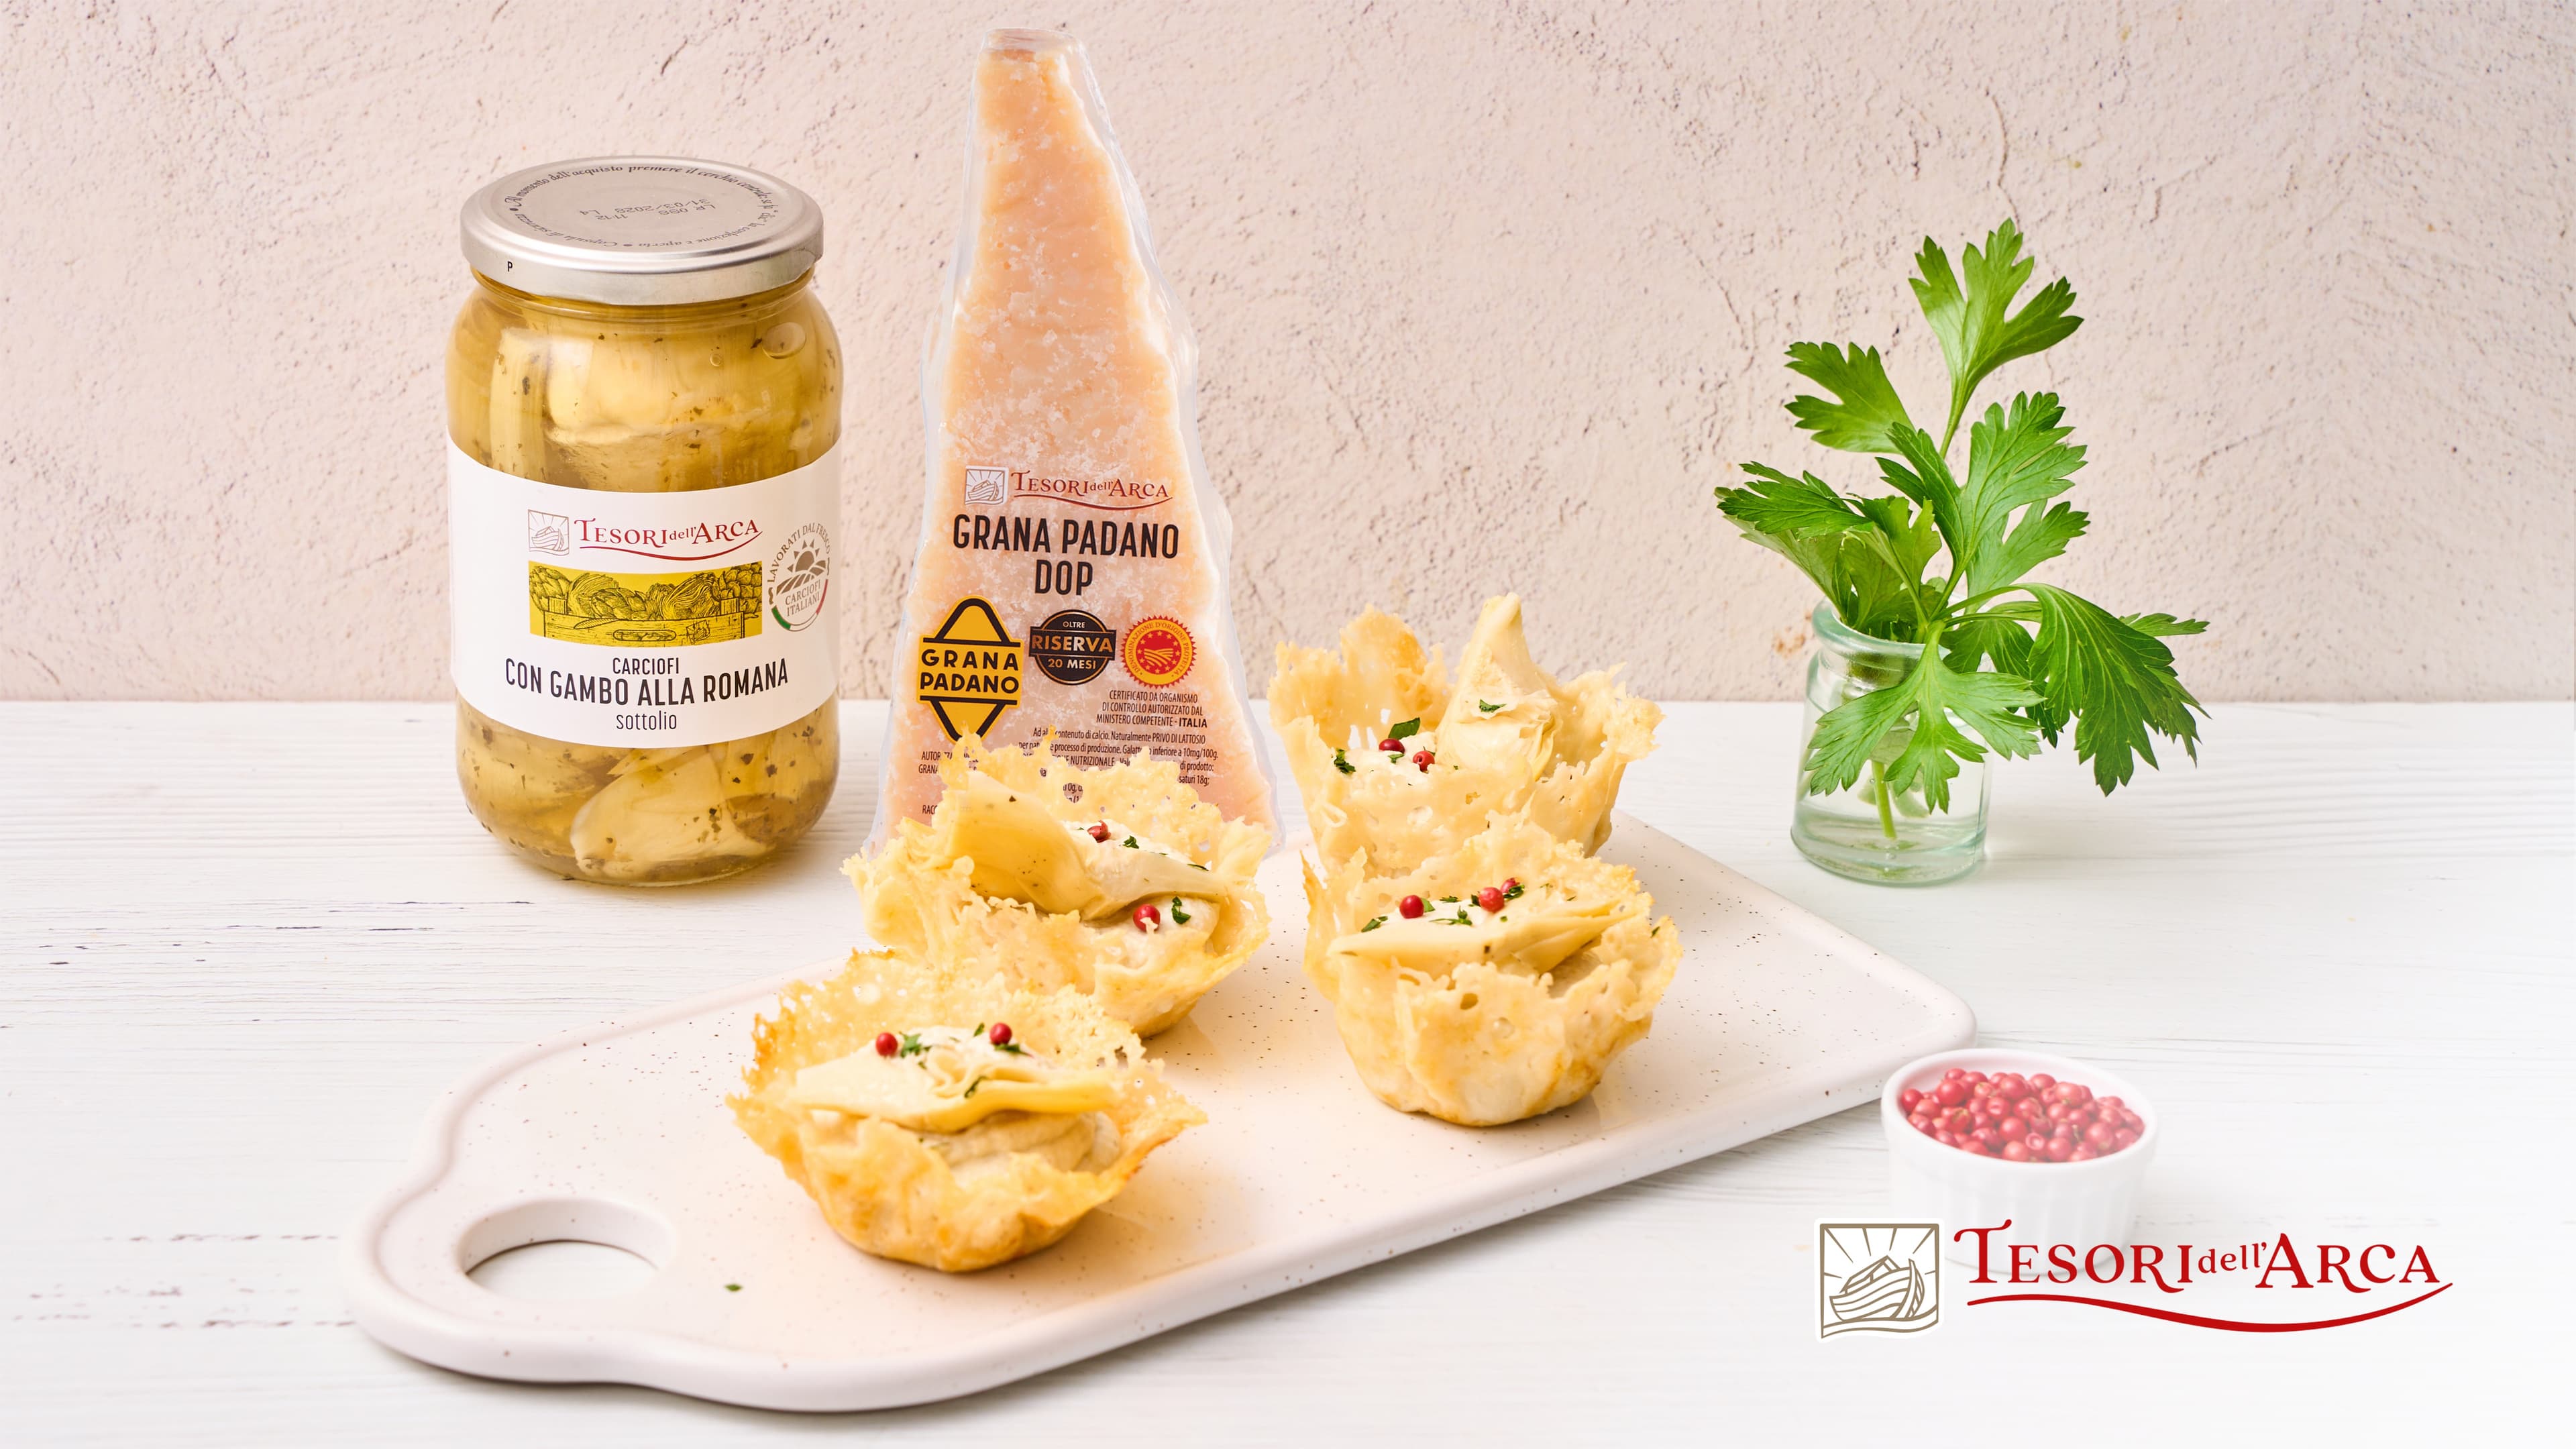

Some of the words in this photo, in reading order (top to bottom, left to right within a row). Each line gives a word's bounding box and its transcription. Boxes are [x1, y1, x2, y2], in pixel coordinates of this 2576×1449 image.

[698, 171, 739, 183] cerchio
[517, 178, 550, 197] momento
[614, 199, 711, 214] 31/03/2028
[564, 235, 618, 247] Capsula
[697, 226, 750, 240] confezione
[506, 261, 513, 272] P
[953, 514, 1051, 553] GRANA
[1061, 519, 1179, 559] PADANO
[767, 529, 801, 583] LAVORATI
[802, 522, 816, 536] DAL
[816, 523, 830, 554] FRESCO
[1034, 559, 1093, 596] DOP
[785, 579, 821, 606] CARCIOFI
[786, 592, 820, 618] ITALIANI
[1062, 621, 1085, 629] OLTRE
[1031, 634, 1114, 653] RISERVA
[1128, 623, 1154, 674] DENOMINAZIONE
[1174, 642, 1190, 676] PROTETTA
[612, 657, 680, 676] CARCIOFI
[921, 648, 1019, 672] GRANA
[1048, 658, 1063, 669] 20
[1067, 659, 1097, 670] MESI
[505, 657, 542, 694] CON
[550, 670, 629, 706] GAMBO
[637, 677, 695, 706] ALLA
[703, 657, 789, 702] ROMANA
[920, 672, 1020, 694] PADANO
[1109, 690, 1148, 702] CERTIFICATO
[1149, 692, 1158, 701] DA
[1159, 692, 1198, 704] ORGANISMO
[1102, 702, 1110, 711] DI
[1110, 702, 1147, 713] CONTROLLO
[1148, 704, 1190, 716] AUTORIZZATO
[1191, 706, 1203, 716] DAL
[616, 710, 678, 731] sottolio
[1096, 714, 1131, 724] MINISTERO
[1132, 715, 1173, 727] COMPETENTE
[1179, 718, 1208, 728] ITALIA
[1033, 727, 1041, 737] Ad
[1085, 731, 1091, 739] di
[1111, 731, 1152, 743] Naturalmente
[1152, 733, 1170, 743] PRIVO
[1171, 734, 1177, 743] DI
[1178, 735, 1206, 745] LATTOSIO
[1055, 744, 1080, 754] processo
[1081, 743, 1086, 752] di
[1087, 744, 1121, 754] produzione.
[1152, 746, 1177, 757] inferiore
[1071, 755, 1115, 767] NUTRIZIONALE
[1180, 761, 1186, 769] di
[1187, 762, 1214, 773] prodotto:
[1179, 775, 1195, 784] saturi
[1197, 775, 1210, 786] 18g;
